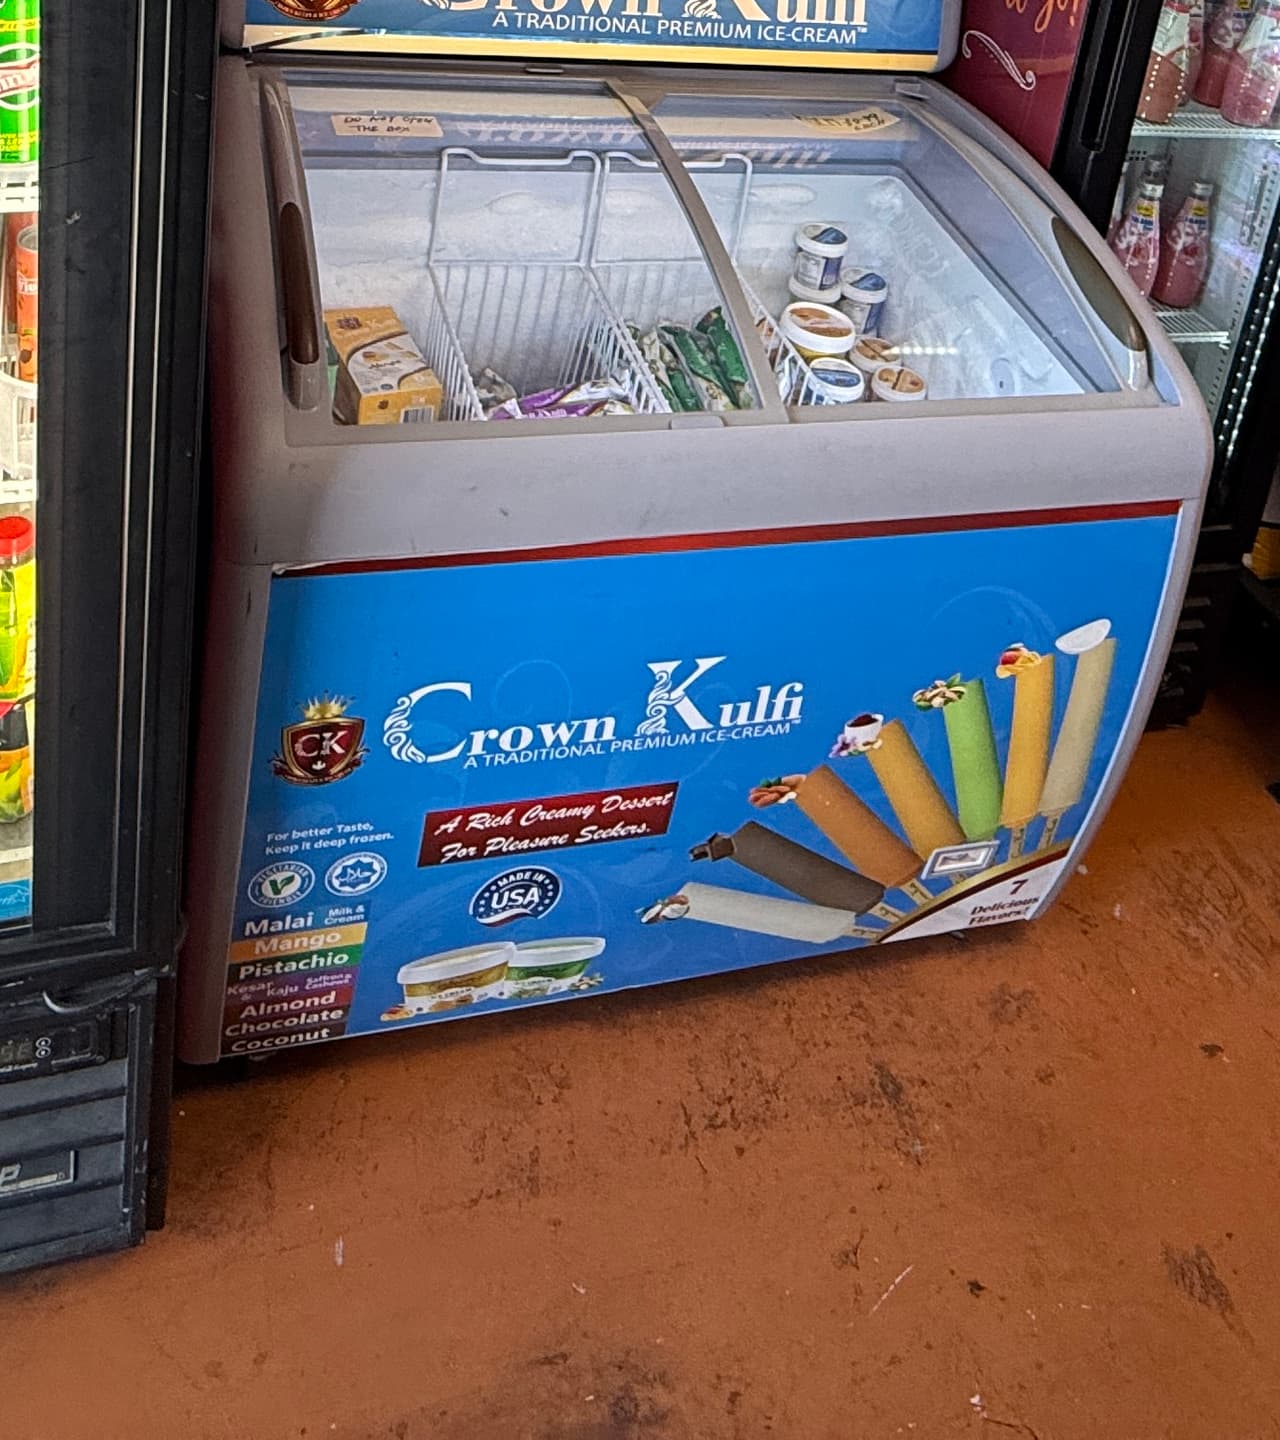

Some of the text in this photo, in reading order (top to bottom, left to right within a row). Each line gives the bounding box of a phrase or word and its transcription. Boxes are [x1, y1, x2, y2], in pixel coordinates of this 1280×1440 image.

[491, 11, 752, 41] A TRADITIONAL PREMIUM
[384, 655, 805, 764] Crown Kulfi
[295, 730, 345, 759] CK
[463, 733, 697, 770] A TRADITIONAL PREMIUM
[433, 791, 673, 836] A Rich Creamy Dessert
[265, 831, 395, 856] Keep it deep frozen.
[266, 821, 375, 843] For better Taste,
[439, 822, 652, 864] For Pleasure Seekers.
[258, 862, 310, 884] VEGETARIAN
[497, 870, 546, 888] MADE IN
[490, 886, 541, 910] USA
[1009, 879, 1029, 895] 7
[328, 904, 365, 918] Milk &
[970, 896, 1040, 916] Delicious
[244, 911, 315, 937] Malai
[324, 913, 365, 926] Cream
[254, 932, 342, 955] Mango
[239, 952, 350, 981] Pistachio
[306, 973, 344, 984] Saffron
[226, 981, 274, 996] Kesar
[267, 984, 299, 997] Kaju
[239, 990, 337, 1019] Almond
[224, 1009, 345, 1037] Chocolate
[230, 1027, 331, 1053] Coconut
